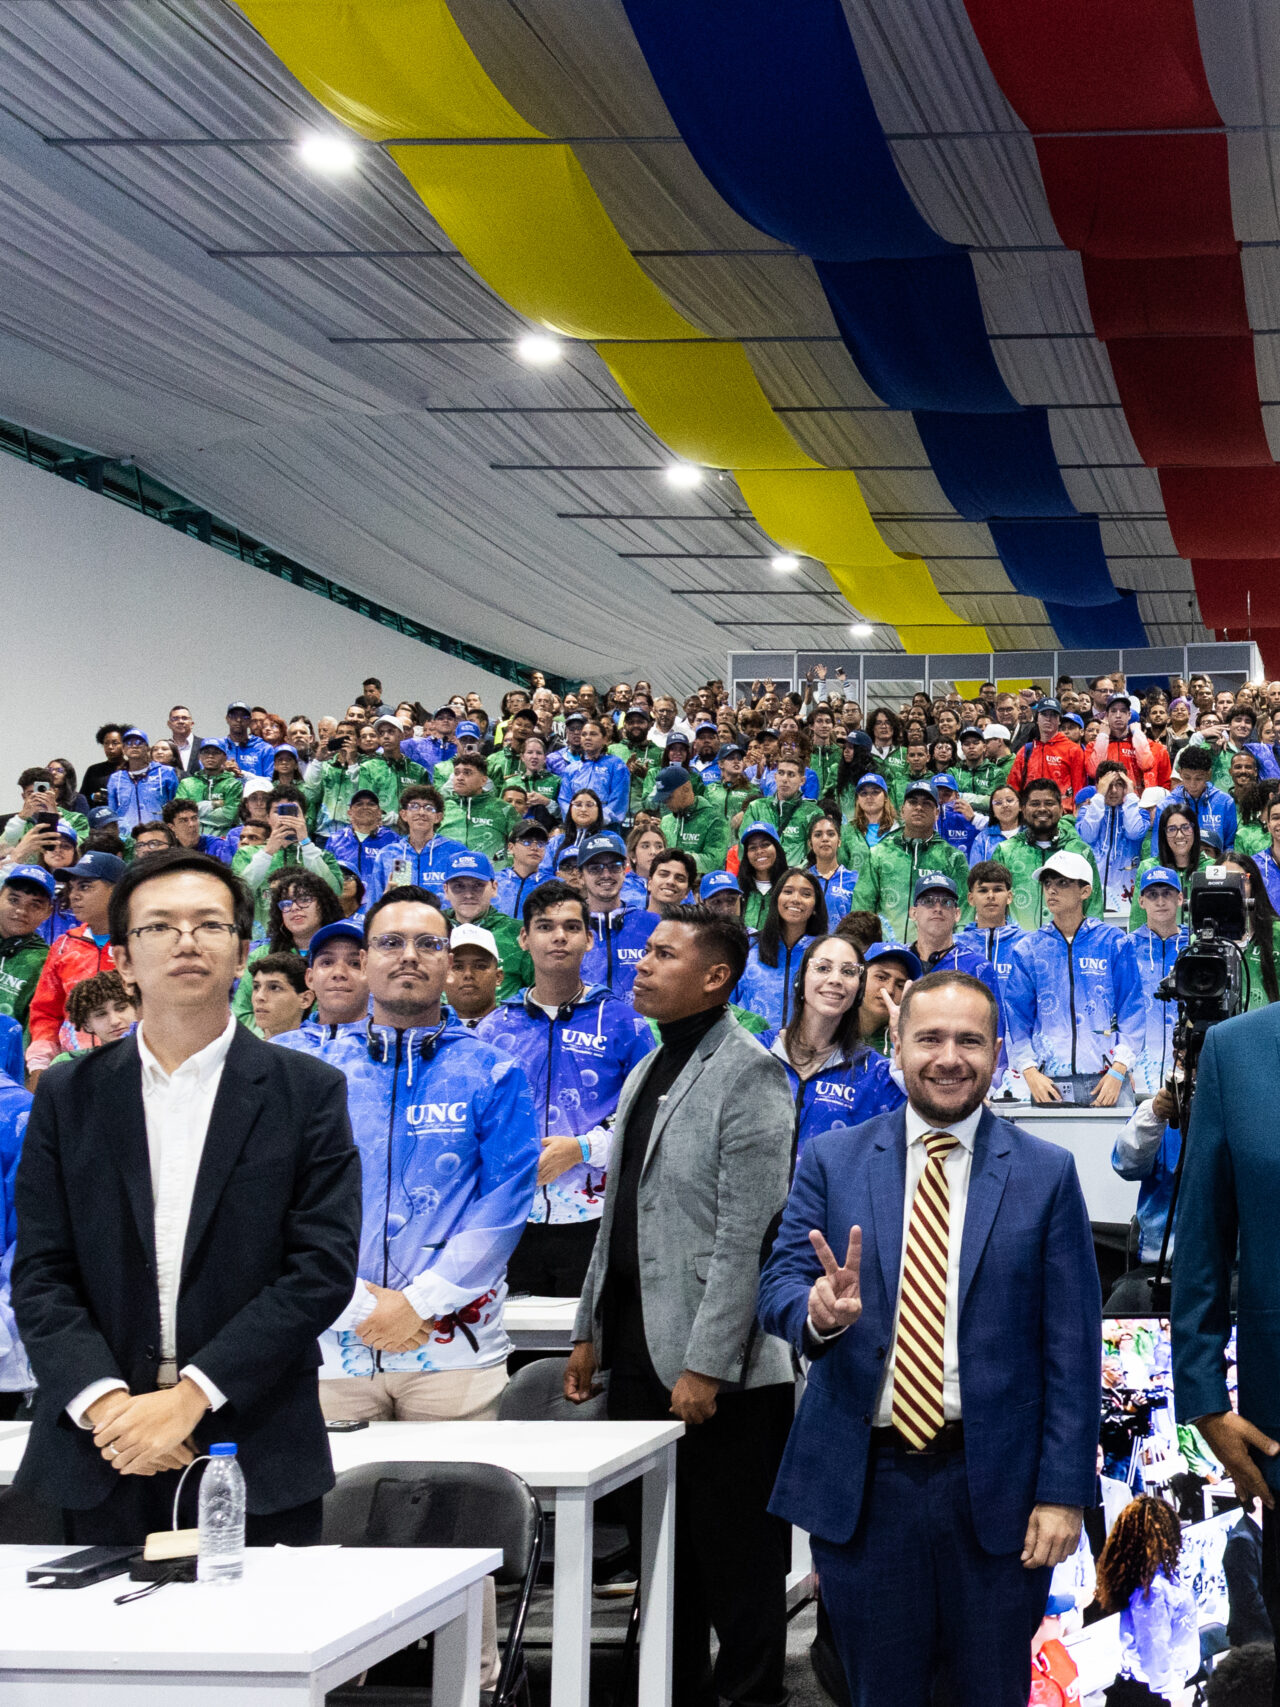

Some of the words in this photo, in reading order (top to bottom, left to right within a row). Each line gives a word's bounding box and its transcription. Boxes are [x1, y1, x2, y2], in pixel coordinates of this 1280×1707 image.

[1046, 755, 1062, 763] UNC
[471, 817, 494, 826] UNC
[1202, 814, 1222, 823] UNC
[682, 833, 700, 841] UNC
[948, 829, 968, 837] UNC
[1212, 868, 1220, 876] 2
[1079, 957, 1107, 970] UNC
[561, 1028, 608, 1051] UNC
[815, 1080, 856, 1102] UNC
[406, 1101, 468, 1125] UNC
